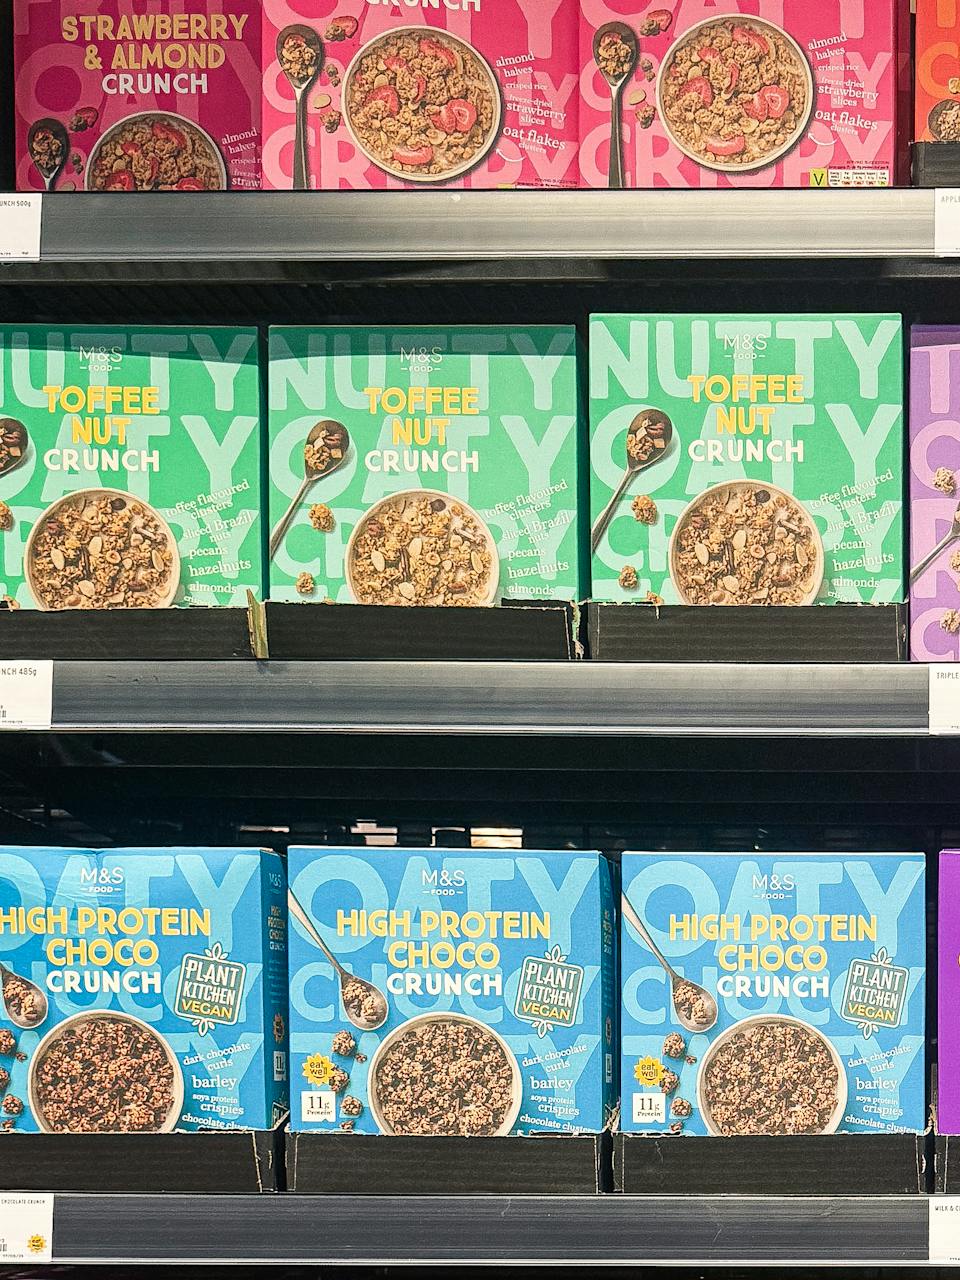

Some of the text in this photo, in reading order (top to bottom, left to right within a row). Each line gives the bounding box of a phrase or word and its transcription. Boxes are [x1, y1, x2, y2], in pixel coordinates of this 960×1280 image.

[62, 14, 248, 42] STRAWBERRY
[808, 33, 847, 50] almond
[84, 42, 225, 70] & ALMOND
[102, 73, 208, 94] CRUNCH
[818, 85, 879, 102] strawberry
[815, 109, 878, 131] oat flakes
[687, 374, 804, 403] TOFFEE
[716, 406, 775, 435] NUT
[689, 439, 804, 462] CRUNCH
[833, 554, 894, 571] hazelnuts
[422, 870, 465, 885] M&S
[337, 909, 551, 939] HIGH PROTEIN
[669, 914, 877, 941] HIGH PROTEIN
[388, 942, 500, 969] CHOCO
[718, 945, 827, 971] CHOCO
[387, 973, 503, 995] CRUNCH
[717, 976, 829, 998] CRUNCH
[853, 965, 903, 988] PLANT
[850, 986, 899, 1009] KITCHEN
[847, 1003, 895, 1022] VEGAN
[192, 1075, 237, 1089] barley
